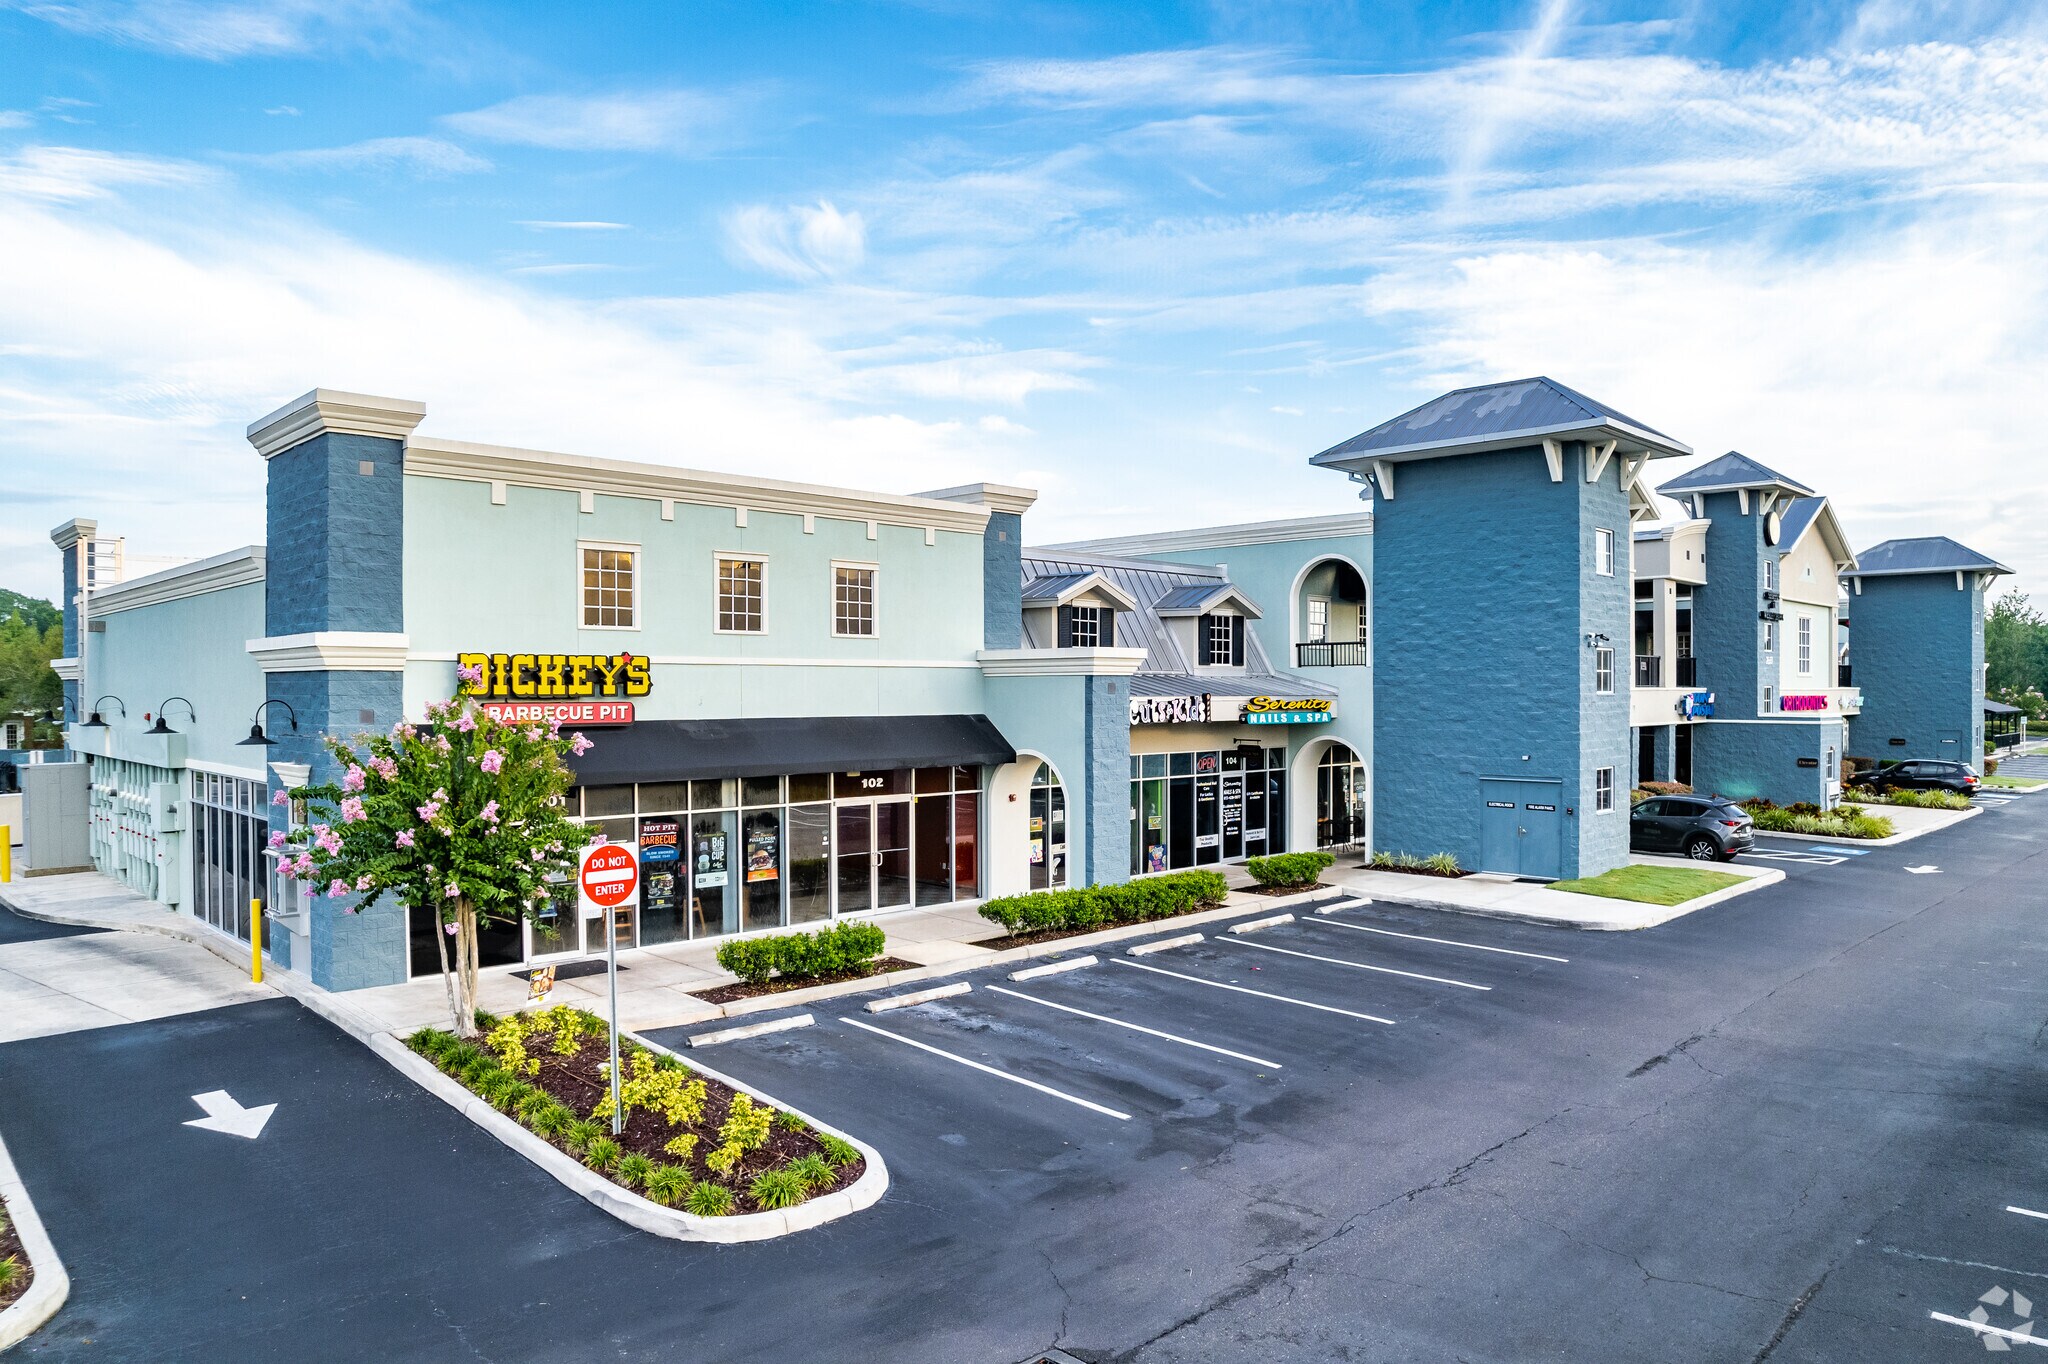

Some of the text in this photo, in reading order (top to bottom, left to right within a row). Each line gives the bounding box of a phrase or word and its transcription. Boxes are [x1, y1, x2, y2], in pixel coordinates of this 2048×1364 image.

[458, 652, 652, 698] DICKEY'S
[1247, 696, 1332, 712] Serenity
[488, 705, 627, 721] BARBECUE PIT
[1250, 713, 1287, 723] NAILS
[1307, 713, 1328, 722] SPA
[1198, 757, 1216, 770] OPEN
[1225, 757, 1237, 765] 104
[861, 777, 884, 788] 102
[640, 834, 677, 846] BARBECUE
[592, 856, 627, 869] DO NOT
[595, 883, 625, 896] ENTER
